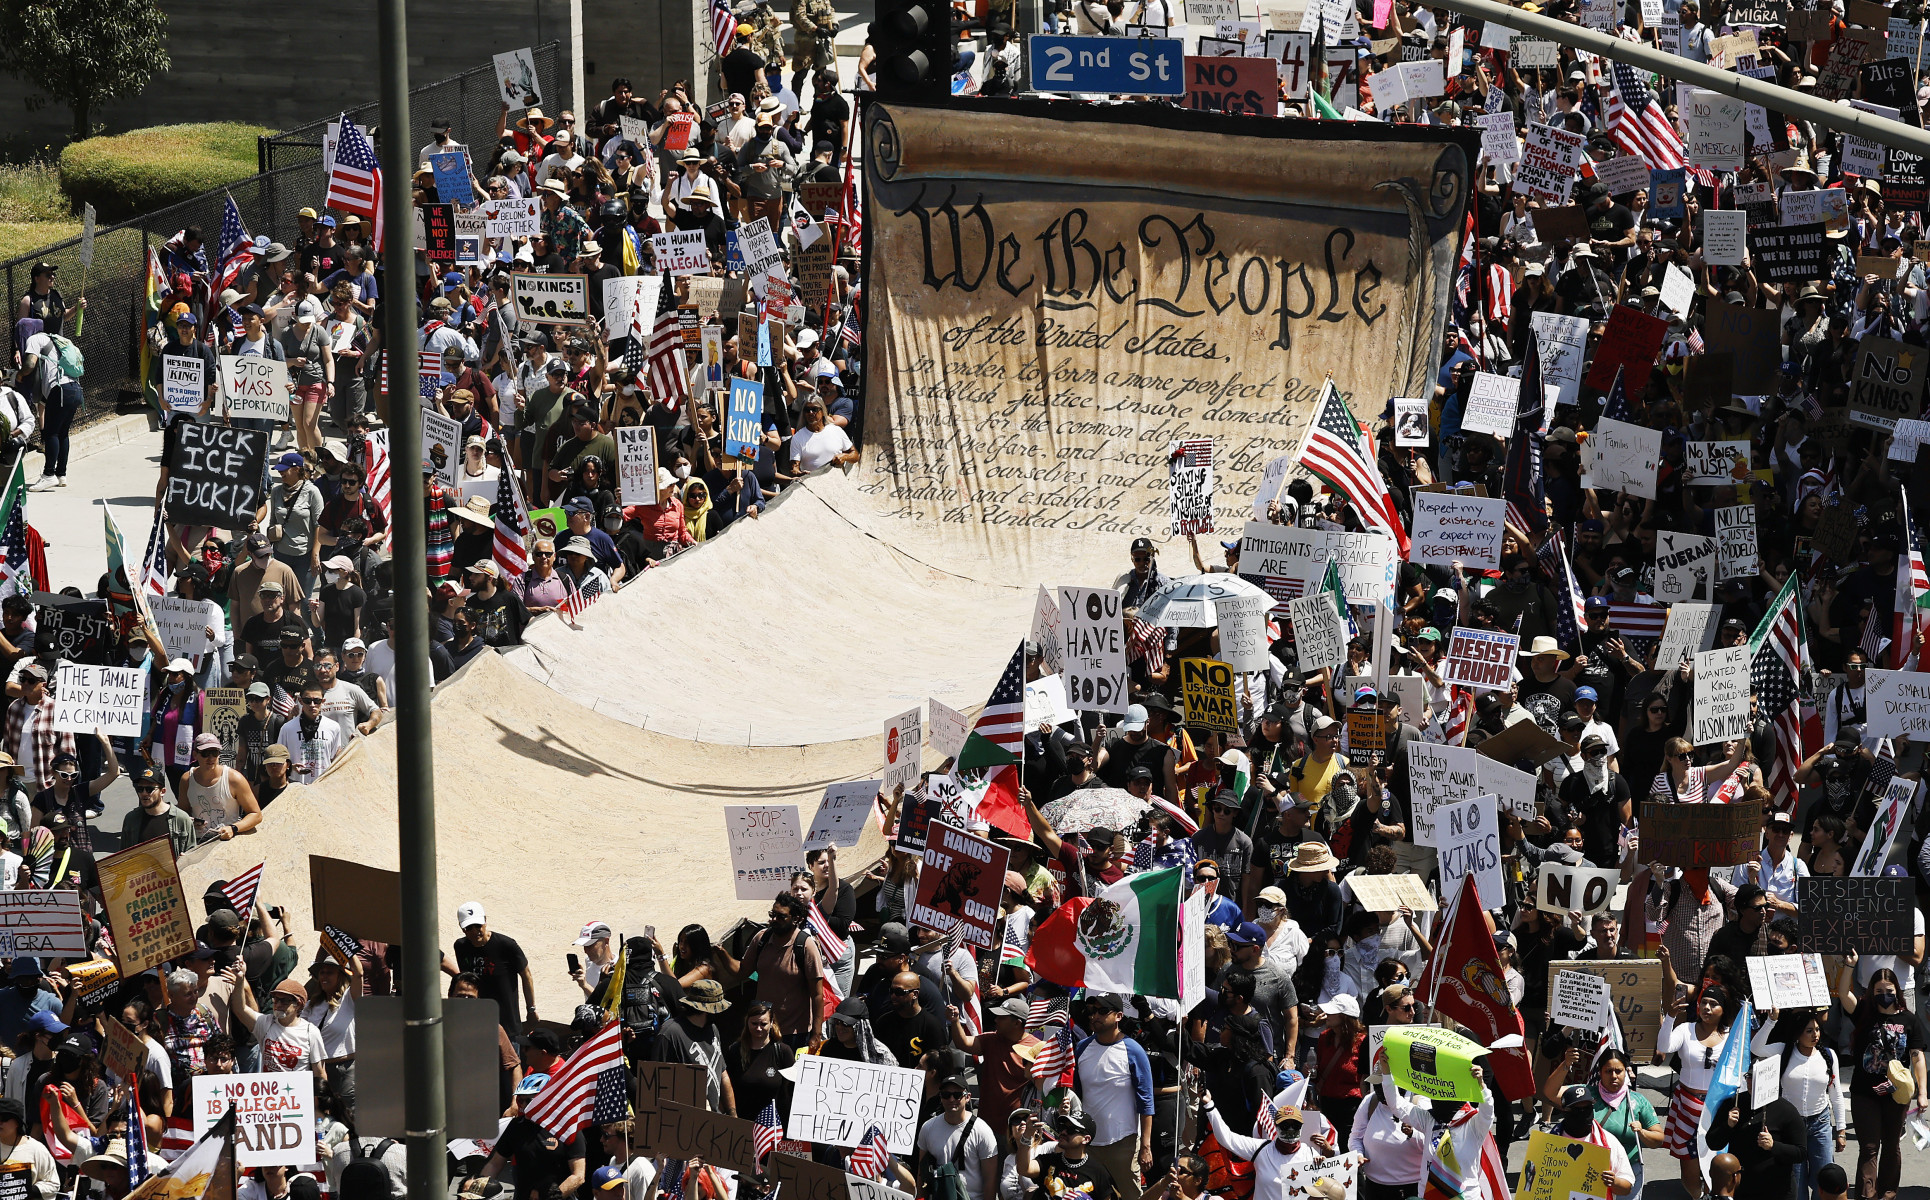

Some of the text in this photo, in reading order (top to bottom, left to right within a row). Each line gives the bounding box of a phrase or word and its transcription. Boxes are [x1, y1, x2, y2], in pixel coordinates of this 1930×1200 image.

[1402, 46, 1428, 60] PEOPLE
[1520, 44, 1553, 63] 8647
[1045, 46, 1170, 82] 2nd St
[1282, 41, 1304, 91] 4
[1739, 55, 1756, 71] FDT
[1195, 64, 1238, 87] NO
[1695, 104, 1711, 116] NO
[1530, 124, 1581, 148] THE POWER
[1540, 138, 1573, 153] OF THE
[1525, 142, 1572, 163] PEOPLE IS
[1890, 149, 1923, 161] LONG
[1521, 165, 1567, 184] THAN THE
[1524, 153, 1576, 178] STRONGER
[1892, 163, 1917, 174] LIVE
[1517, 173, 1564, 194] PEOPLE IN
[1884, 174, 1900, 184] THE
[432, 207, 443, 216] WE
[494, 199, 527, 210] FAMILIES
[431, 218, 448, 227] WILL
[500, 210, 526, 221] BELONG
[432, 229, 448, 237] NOT
[492, 220, 535, 234] TOGETHER
[437, 240, 445, 248] BE
[655, 232, 702, 247] NO HUMAN
[1755, 233, 1822, 247] DON'T PANIC
[674, 247, 685, 256] IS
[1761, 249, 1821, 262] WE'RE JUST
[657, 254, 708, 272] ILLEGAL
[894, 182, 1388, 350] We the People
[1770, 265, 1818, 277] HISPANIC
[943, 315, 991, 351] of
[979, 318, 1028, 345] the
[1036, 318, 1129, 349] United
[235, 358, 274, 378] STOP
[233, 376, 273, 397] MASS
[1854, 381, 1913, 414] KINGS
[1860, 413, 1881, 424] SINCE
[181, 424, 254, 455] FUCK
[184, 446, 244, 478] ICE
[1700, 460, 1728, 475] USA
[1418, 500, 1483, 518] Respect my
[1439, 516, 1495, 528] existence
[1418, 530, 1496, 545] or expect my
[1421, 544, 1493, 558] RESISTANCE!
[1259, 561, 1288, 576] ARE
[1064, 590, 1118, 621] YOU
[1067, 626, 1119, 658] HAVE
[1454, 630, 1517, 645] CHOOSE LOVE
[1452, 640, 1516, 663] RESIST
[1704, 650, 1742, 666] IF WE
[1081, 657, 1102, 670] THE
[1448, 659, 1510, 685] TRUMP
[1698, 665, 1748, 680] WANTED A
[59, 665, 138, 689] THE TAMALE
[1184, 660, 1231, 687] NO
[61, 690, 140, 707] LADY IS NOT
[1070, 672, 1126, 706] BODY
[1186, 682, 1232, 698] US-ISRAEL
[1190, 695, 1233, 716] WAR
[1697, 696, 1708, 706] WE
[1712, 703, 1734, 715] PICKED
[59, 708, 139, 725] A CRIMINAL
[1188, 711, 1236, 727] ON IRAN!
[1696, 716, 1726, 742] JASON
[1450, 803, 1480, 836] NO
[943, 829, 993, 865] HANDS
[925, 848, 953, 873] OFF
[1442, 833, 1498, 883] KINGS
[128, 871, 158, 889] SUPER
[134, 876, 178, 898] CALLOUS
[1808, 880, 1901, 899] RESPECT
[125, 887, 174, 914] FRAGILE
[1546, 872, 1609, 911] NO
[131, 898, 178, 923] RACIST
[964, 900, 995, 926] OUR
[1801, 898, 1907, 914] EXISTENCE
[128, 911, 174, 937] SEXIST
[912, 904, 991, 947] NEIGHORS
[1845, 912, 1860, 922] OR
[132, 921, 180, 947] TRUMP
[1812, 920, 1894, 936] EXPECT
[128, 932, 183, 962] IS NOT MY
[1802, 936, 1910, 953] RESISTANCE
[145, 943, 191, 968] POTUS
[1402, 1029, 1463, 1051] and tell my kids
[801, 1060, 923, 1100] FIRST THEIR
[1411, 1070, 1422, 1082] did
[1422, 1074, 1456, 1091] nothing
[1411, 1080, 1458, 1099] to stop this!
[225, 1082, 244, 1098] NO
[207, 1095, 301, 1114] IS LLEGAL
[815, 1089, 917, 1120] RIGHTS
[793, 1113, 854, 1142] THEN
